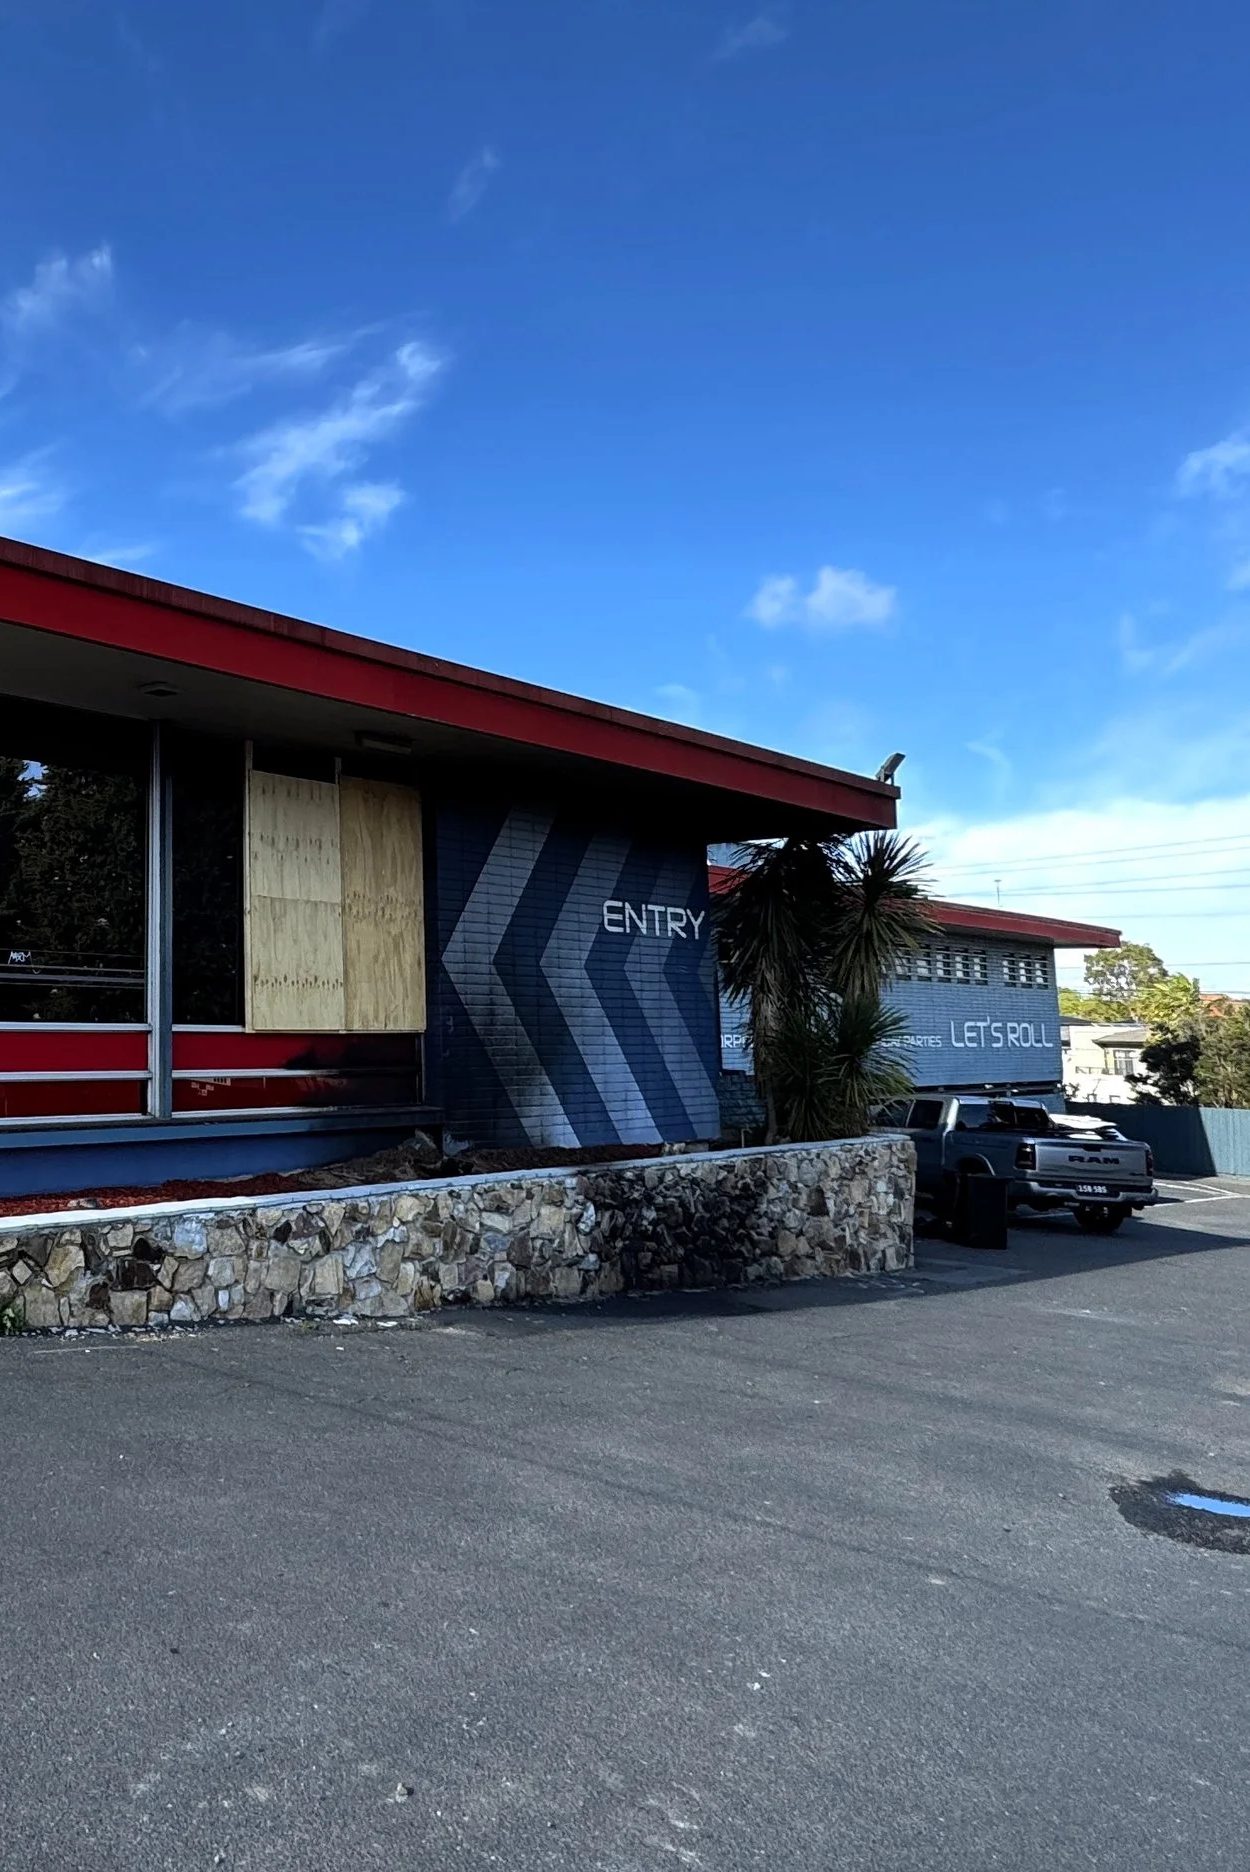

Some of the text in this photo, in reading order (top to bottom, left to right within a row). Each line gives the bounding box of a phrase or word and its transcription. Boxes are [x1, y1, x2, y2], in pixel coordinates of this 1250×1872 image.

[603, 900, 705, 940] ENTRY
[950, 1016, 1054, 1048] LET'S ROLL
[1068, 1155, 1120, 1165] RAM
